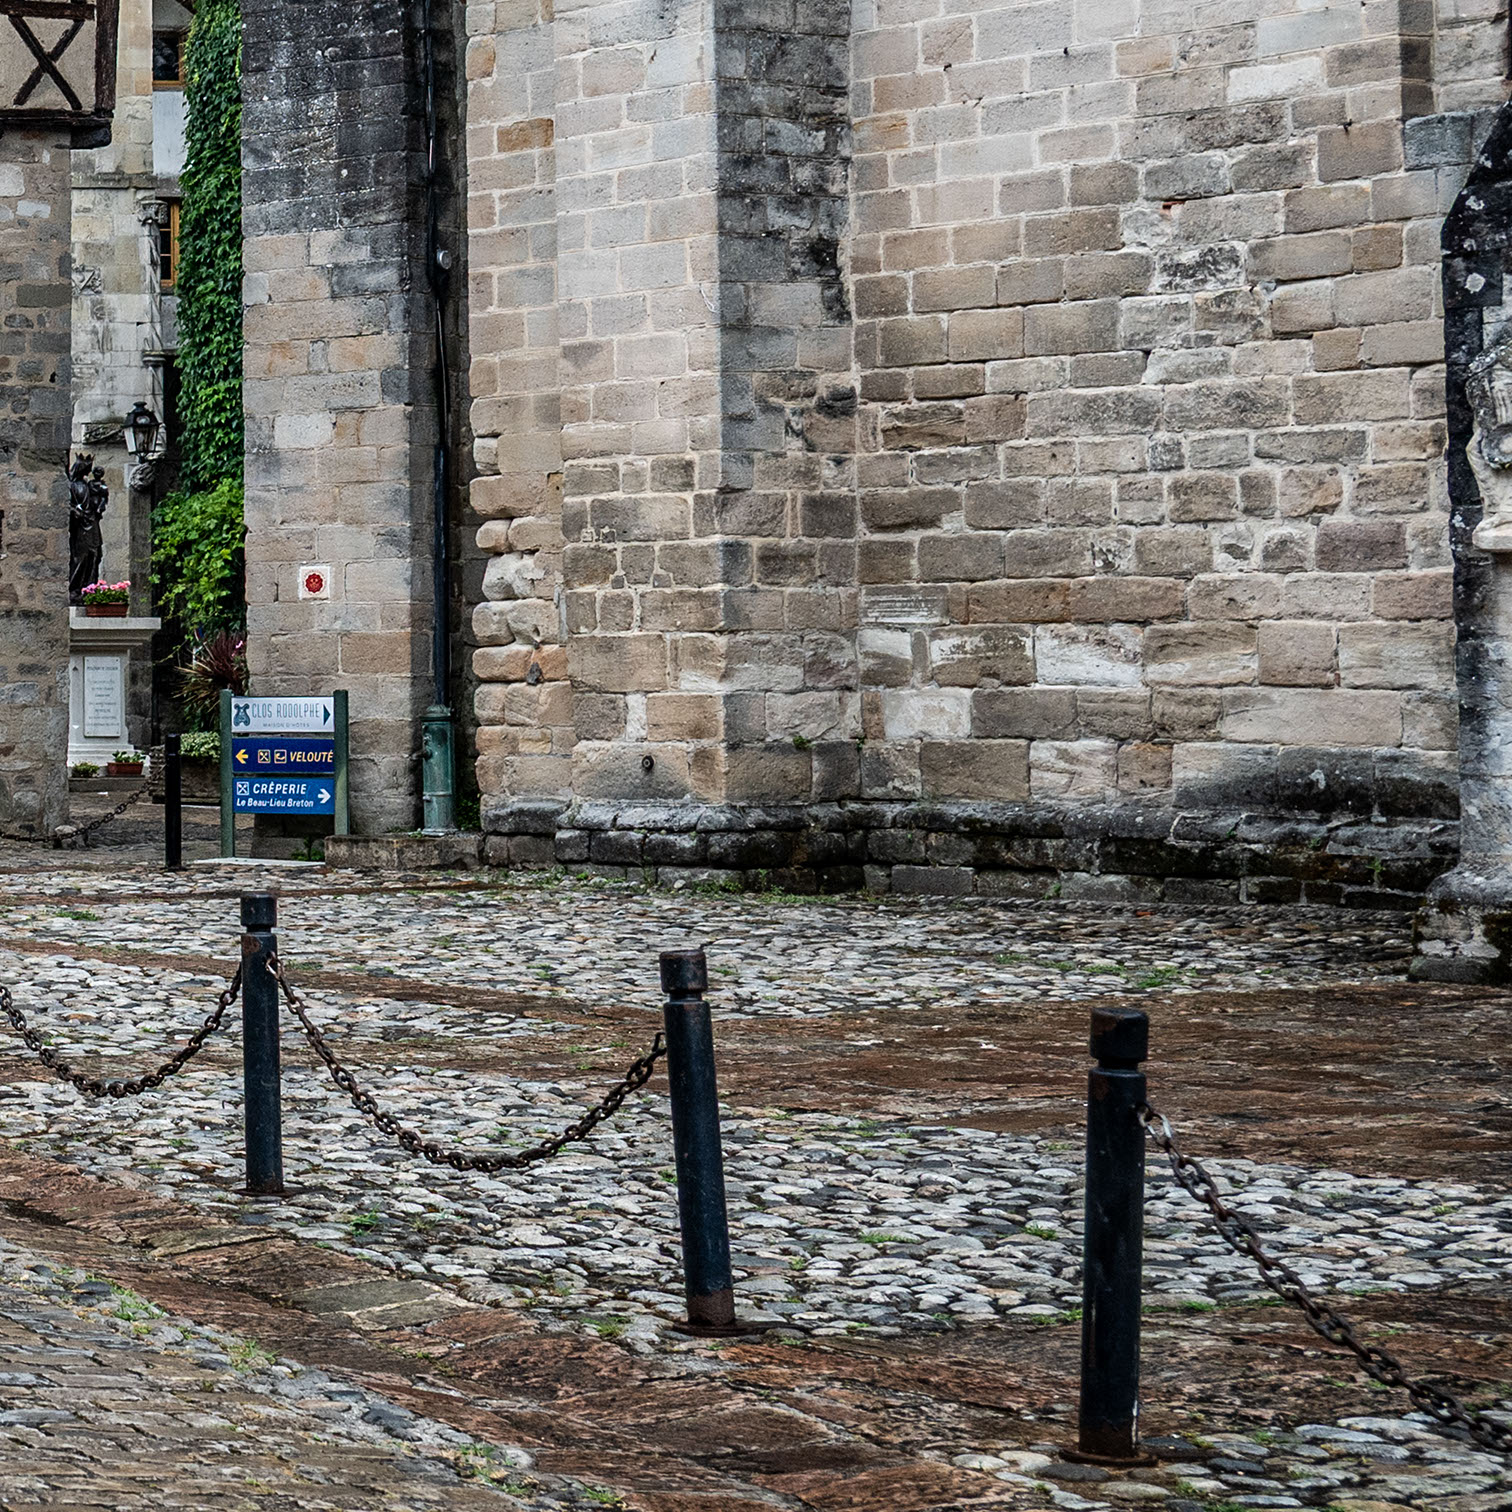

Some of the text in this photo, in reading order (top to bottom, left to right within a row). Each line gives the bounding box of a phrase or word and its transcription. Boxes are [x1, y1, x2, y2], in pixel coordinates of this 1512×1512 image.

[252, 703, 320, 718] CLOS RODOLPHE
[290, 750, 334, 762] VELOUTÉ
[253, 781, 307, 795] CRÊPERIE
[237, 798, 314, 808] Le Beau-Lieu Breton
